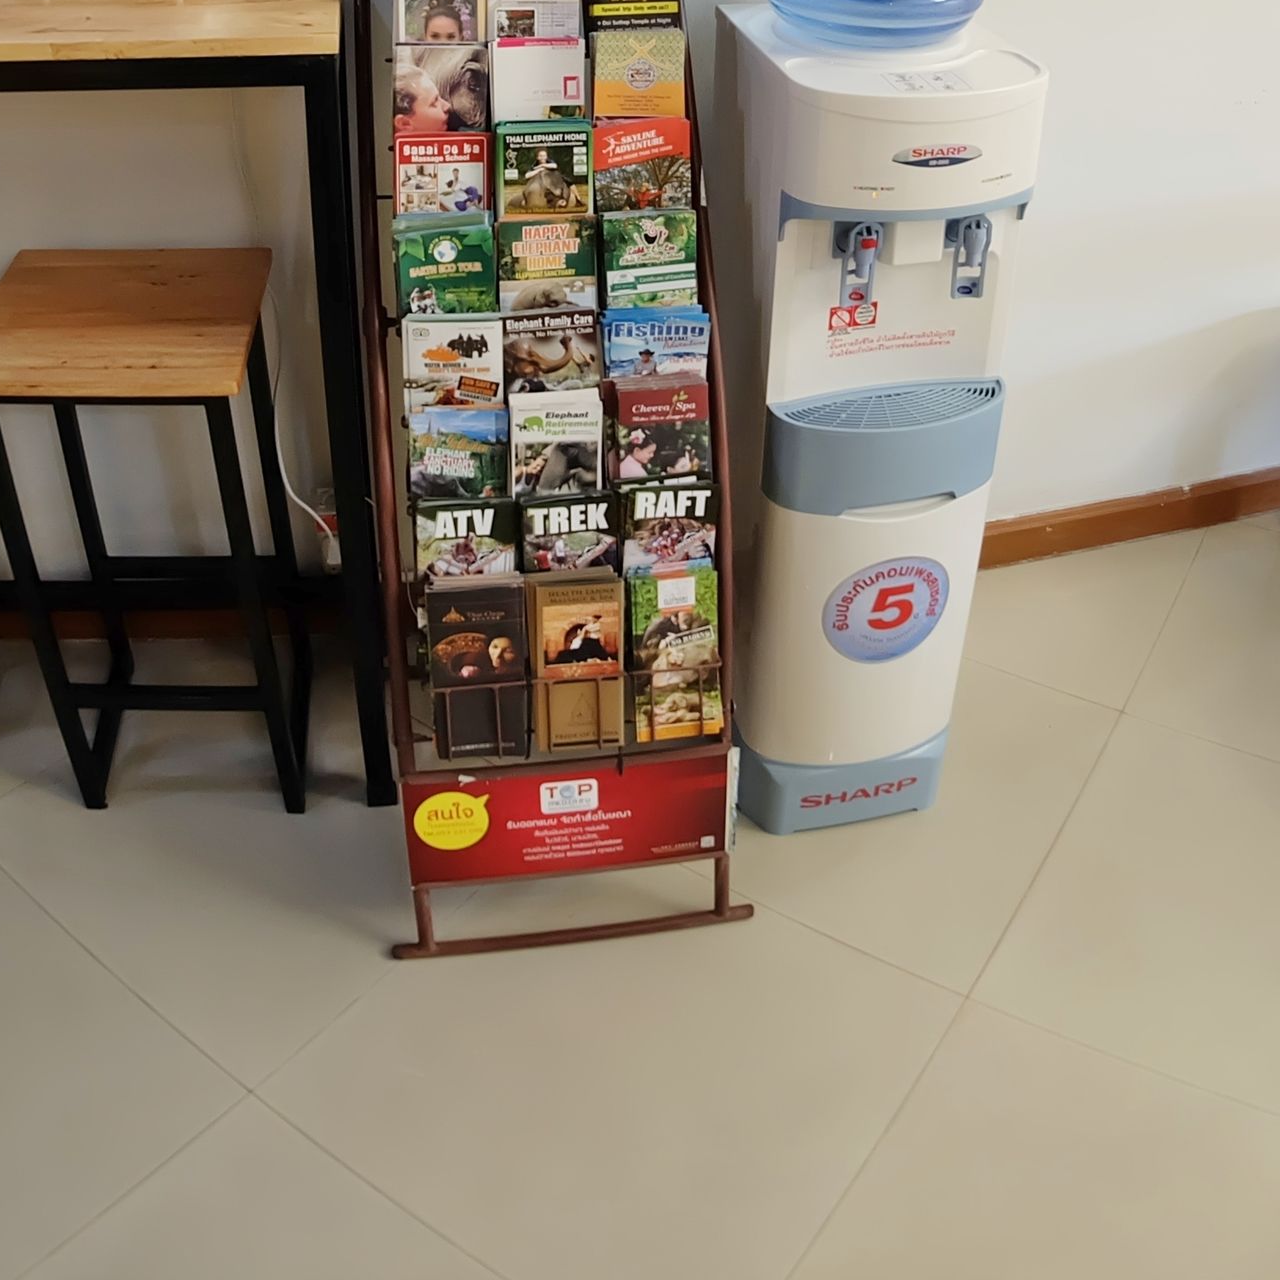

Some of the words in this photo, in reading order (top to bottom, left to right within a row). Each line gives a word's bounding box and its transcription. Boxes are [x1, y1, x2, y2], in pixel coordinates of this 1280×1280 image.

[505, 134, 524, 144] THAI
[525, 133, 564, 144] ELEPHANT
[565, 132, 587, 142] HOME
[621, 129, 657, 144] SKYLINE
[615, 136, 665, 155] ADVENTURE
[911, 145, 968, 159] SHARP
[445, 153, 471, 162] School
[522, 223, 570, 241] HAPPY
[512, 238, 581, 257] ELEPHANT
[527, 253, 568, 271] HOME
[506, 316, 544, 331] Elephant
[544, 314, 572, 328] Family
[573, 312, 594, 324] Care
[612, 320, 705, 338] Fishing
[632, 404, 671, 414] Cheeva
[675, 402, 696, 413] Spa
[545, 411, 589, 422] Elephant
[545, 420, 599, 428] Retirement
[545, 428, 567, 436] Park
[423, 454, 476, 469] SANCTUARY
[425, 447, 471, 460] ELEPHANT
[426, 465, 441, 475] NO
[442, 466, 475, 479] RIDING
[634, 489, 712, 521] RAFT
[435, 508, 495, 539] ATV
[527, 502, 610, 537] TREK
[548, 588, 584, 598] HEALTH
[867, 583, 915, 629] 5
[545, 783, 593, 799] TOP
[800, 776, 918, 809] SHARP
[427, 801, 474, 821] สนใจ
